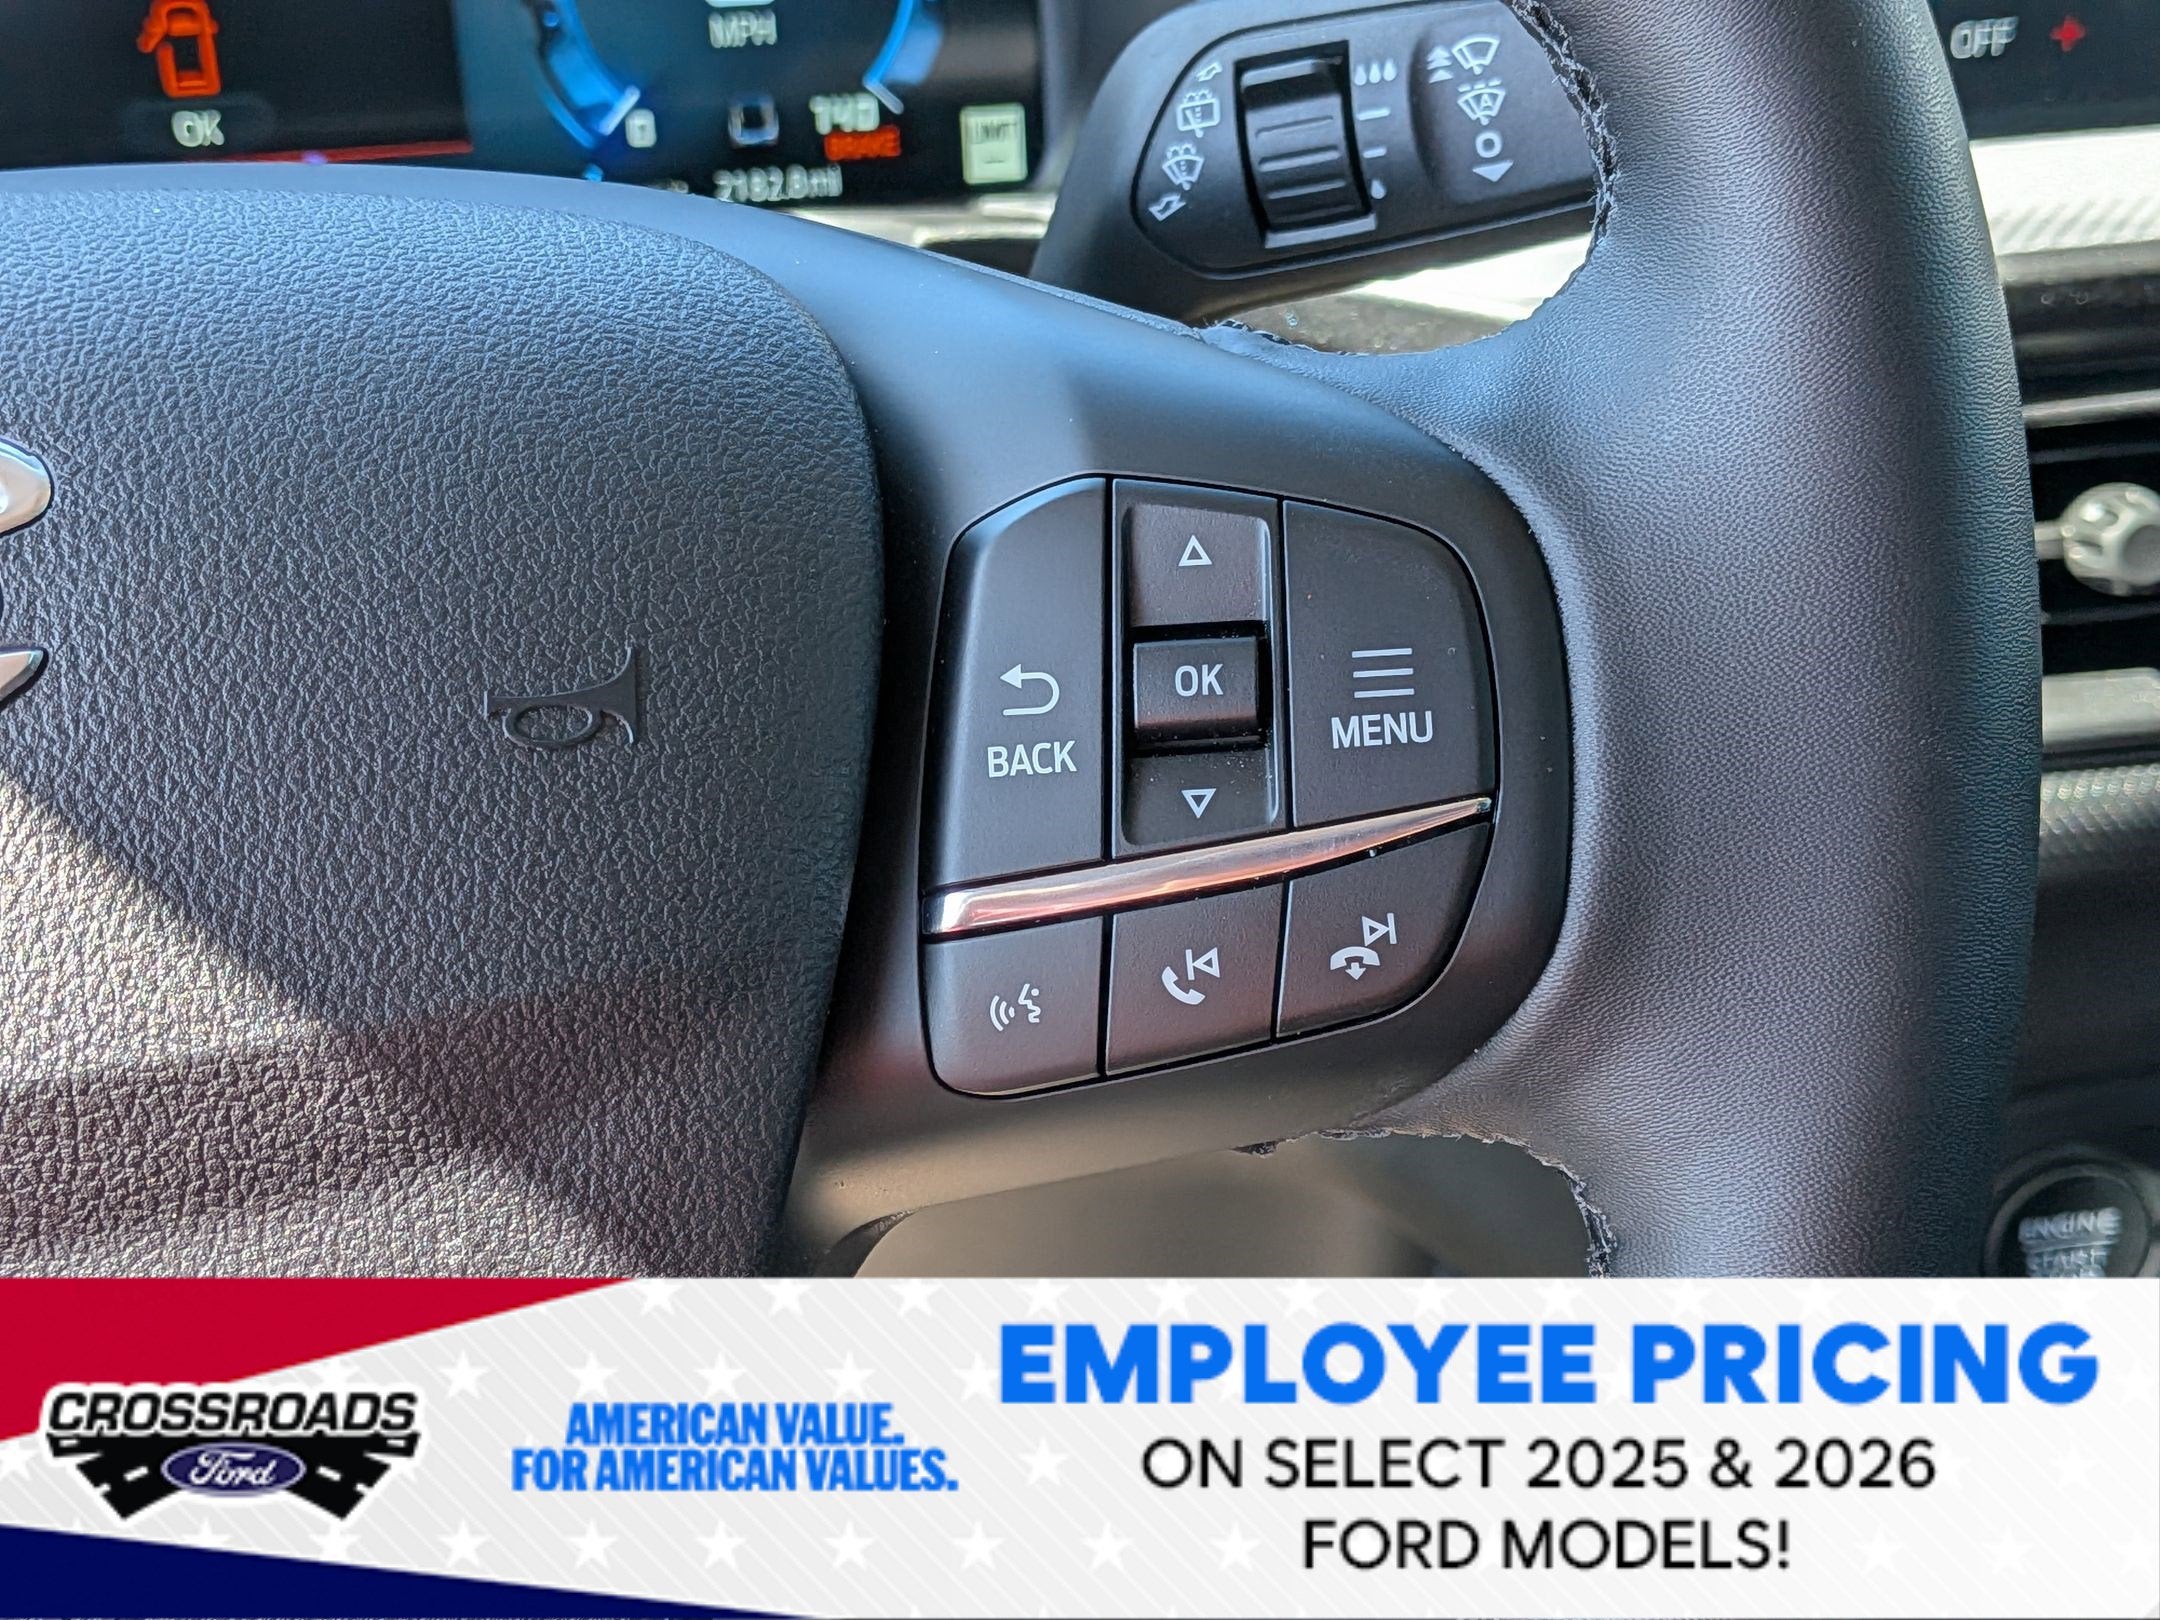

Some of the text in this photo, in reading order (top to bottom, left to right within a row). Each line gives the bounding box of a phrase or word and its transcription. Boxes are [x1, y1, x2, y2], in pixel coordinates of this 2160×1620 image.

[709, 10, 777, 48] MPH
[1951, 16, 2019, 58] OFF
[171, 109, 224, 147] OK
[1174, 663, 1224, 697] OK
[1331, 710, 1434, 750] MENU
[987, 740, 1078, 779] BACK
[2018, 1207, 2123, 1242] ENGINE
